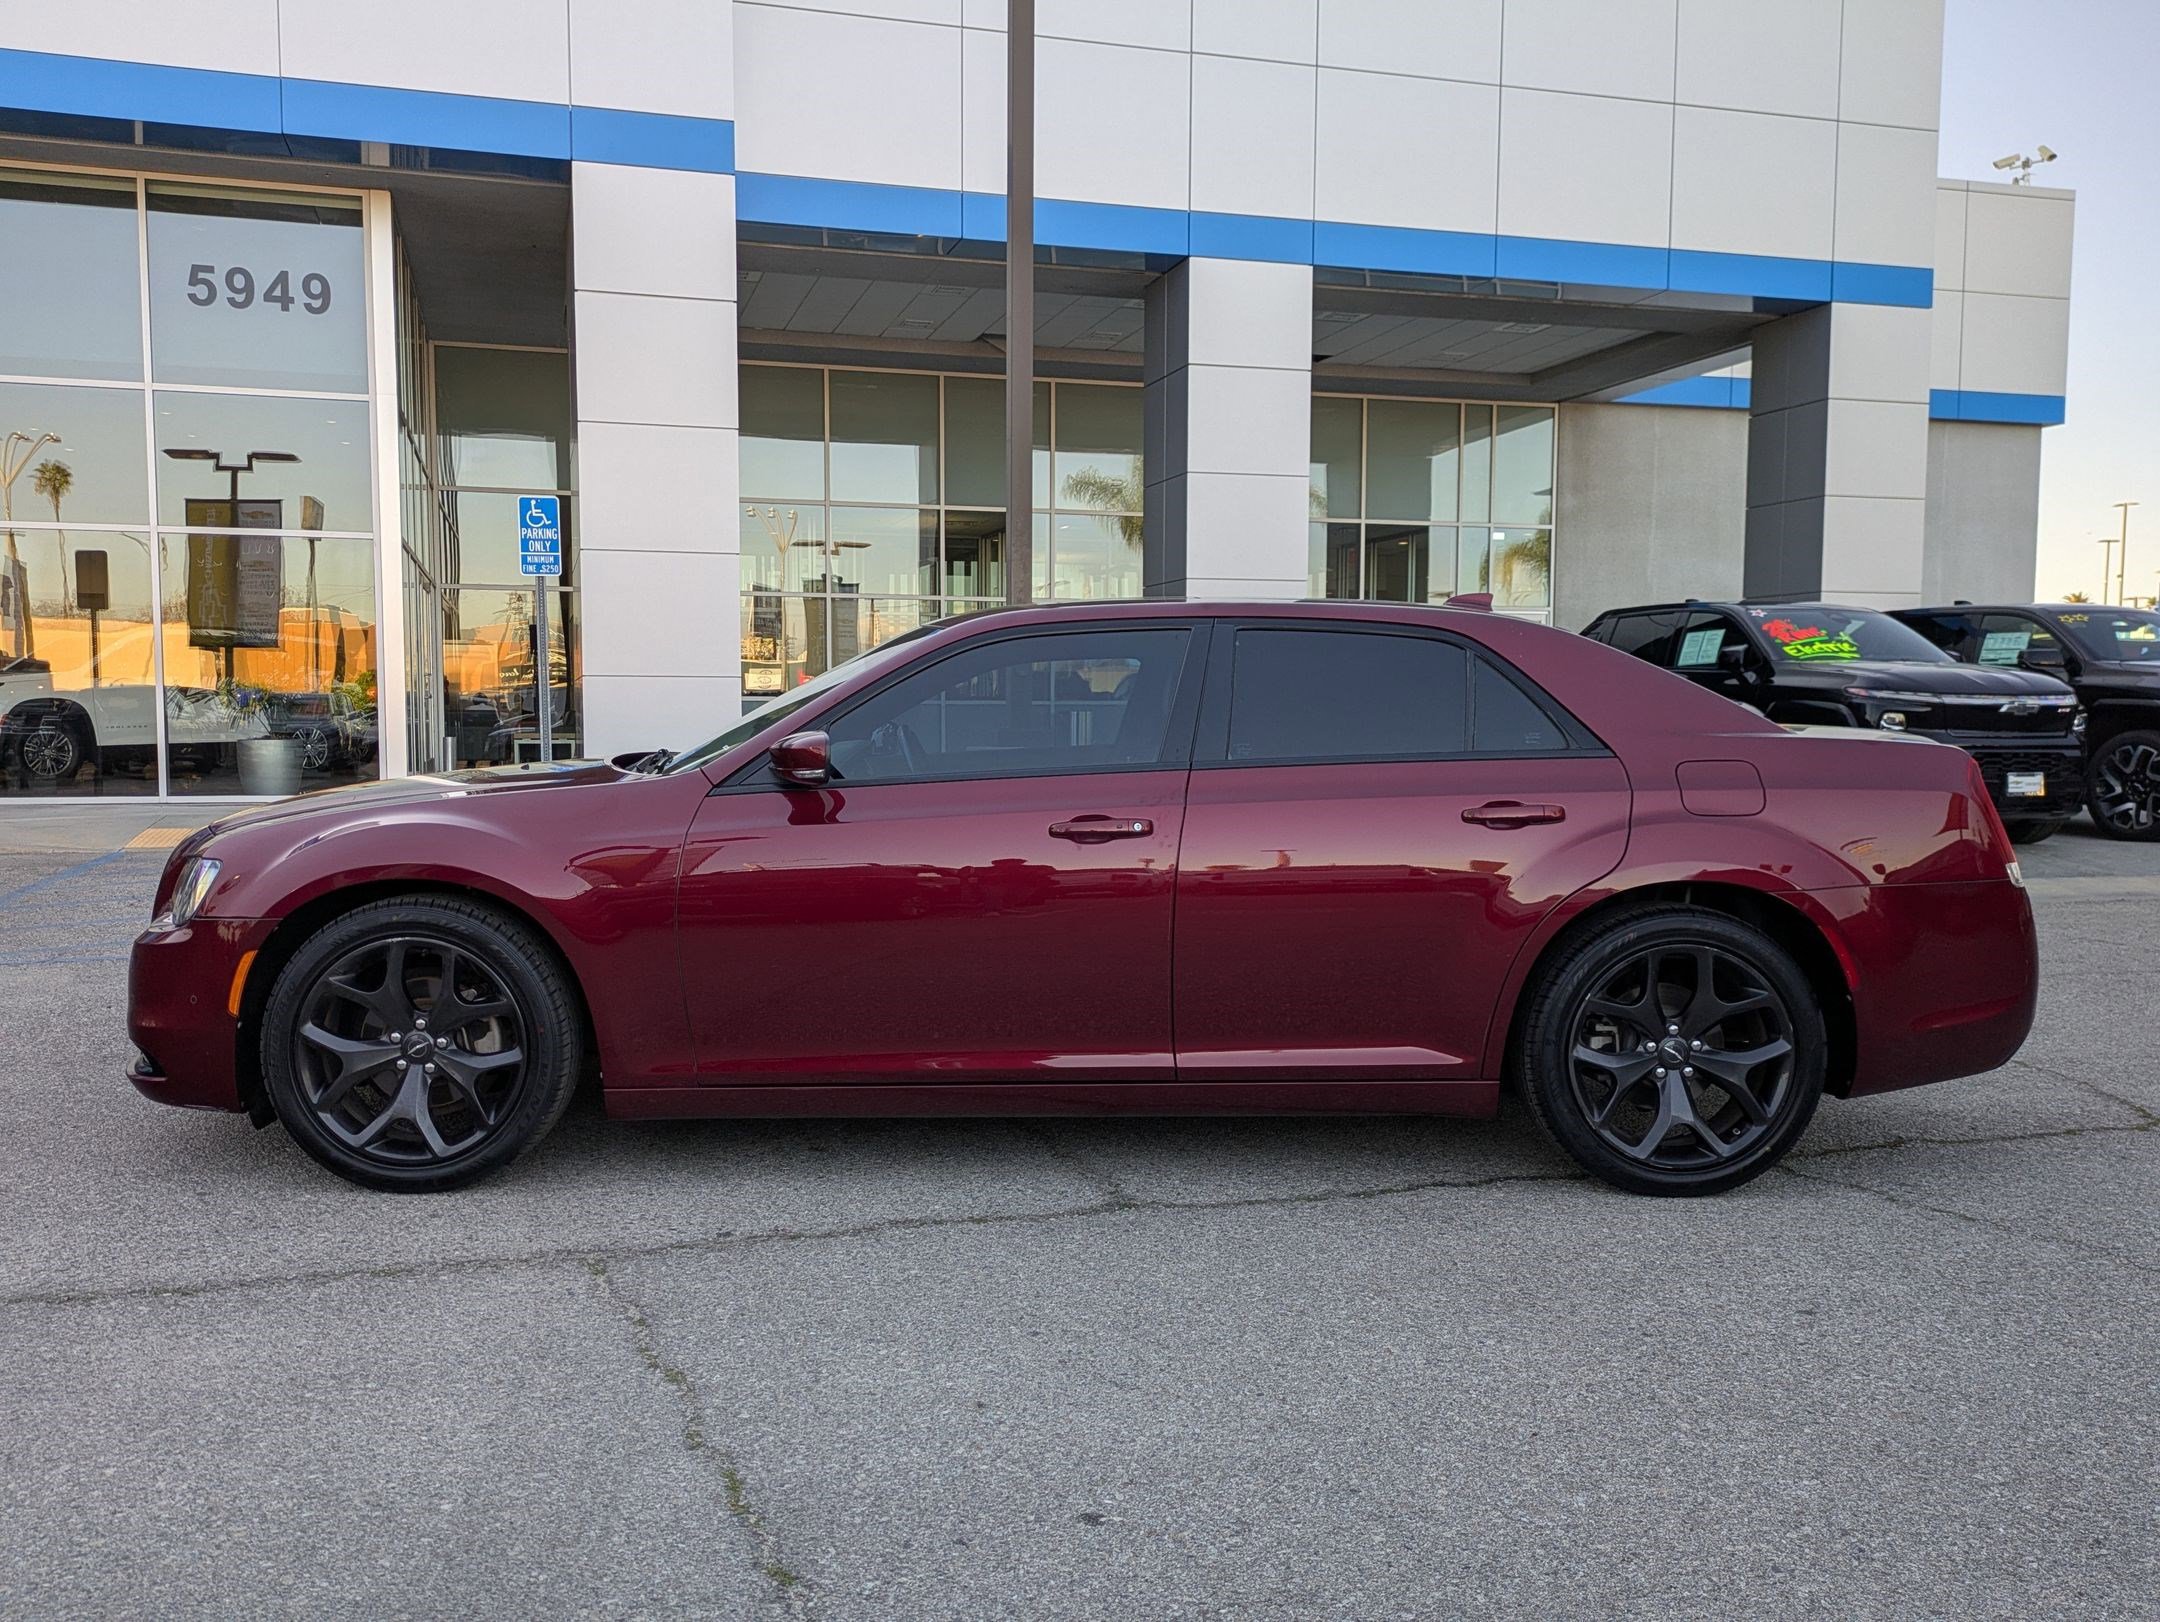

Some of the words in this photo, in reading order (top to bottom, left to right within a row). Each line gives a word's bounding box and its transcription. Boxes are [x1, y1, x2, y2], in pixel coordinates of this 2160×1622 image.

[187, 264, 331, 315] 5949
[521, 528, 558, 540] PARKING
[528, 540, 551, 552] ONLY
[526, 555, 554, 563] MINIMUM
[522, 564, 537, 573] FINE
[541, 564, 559, 573] $250
[1782, 641, 1858, 657] Electric
